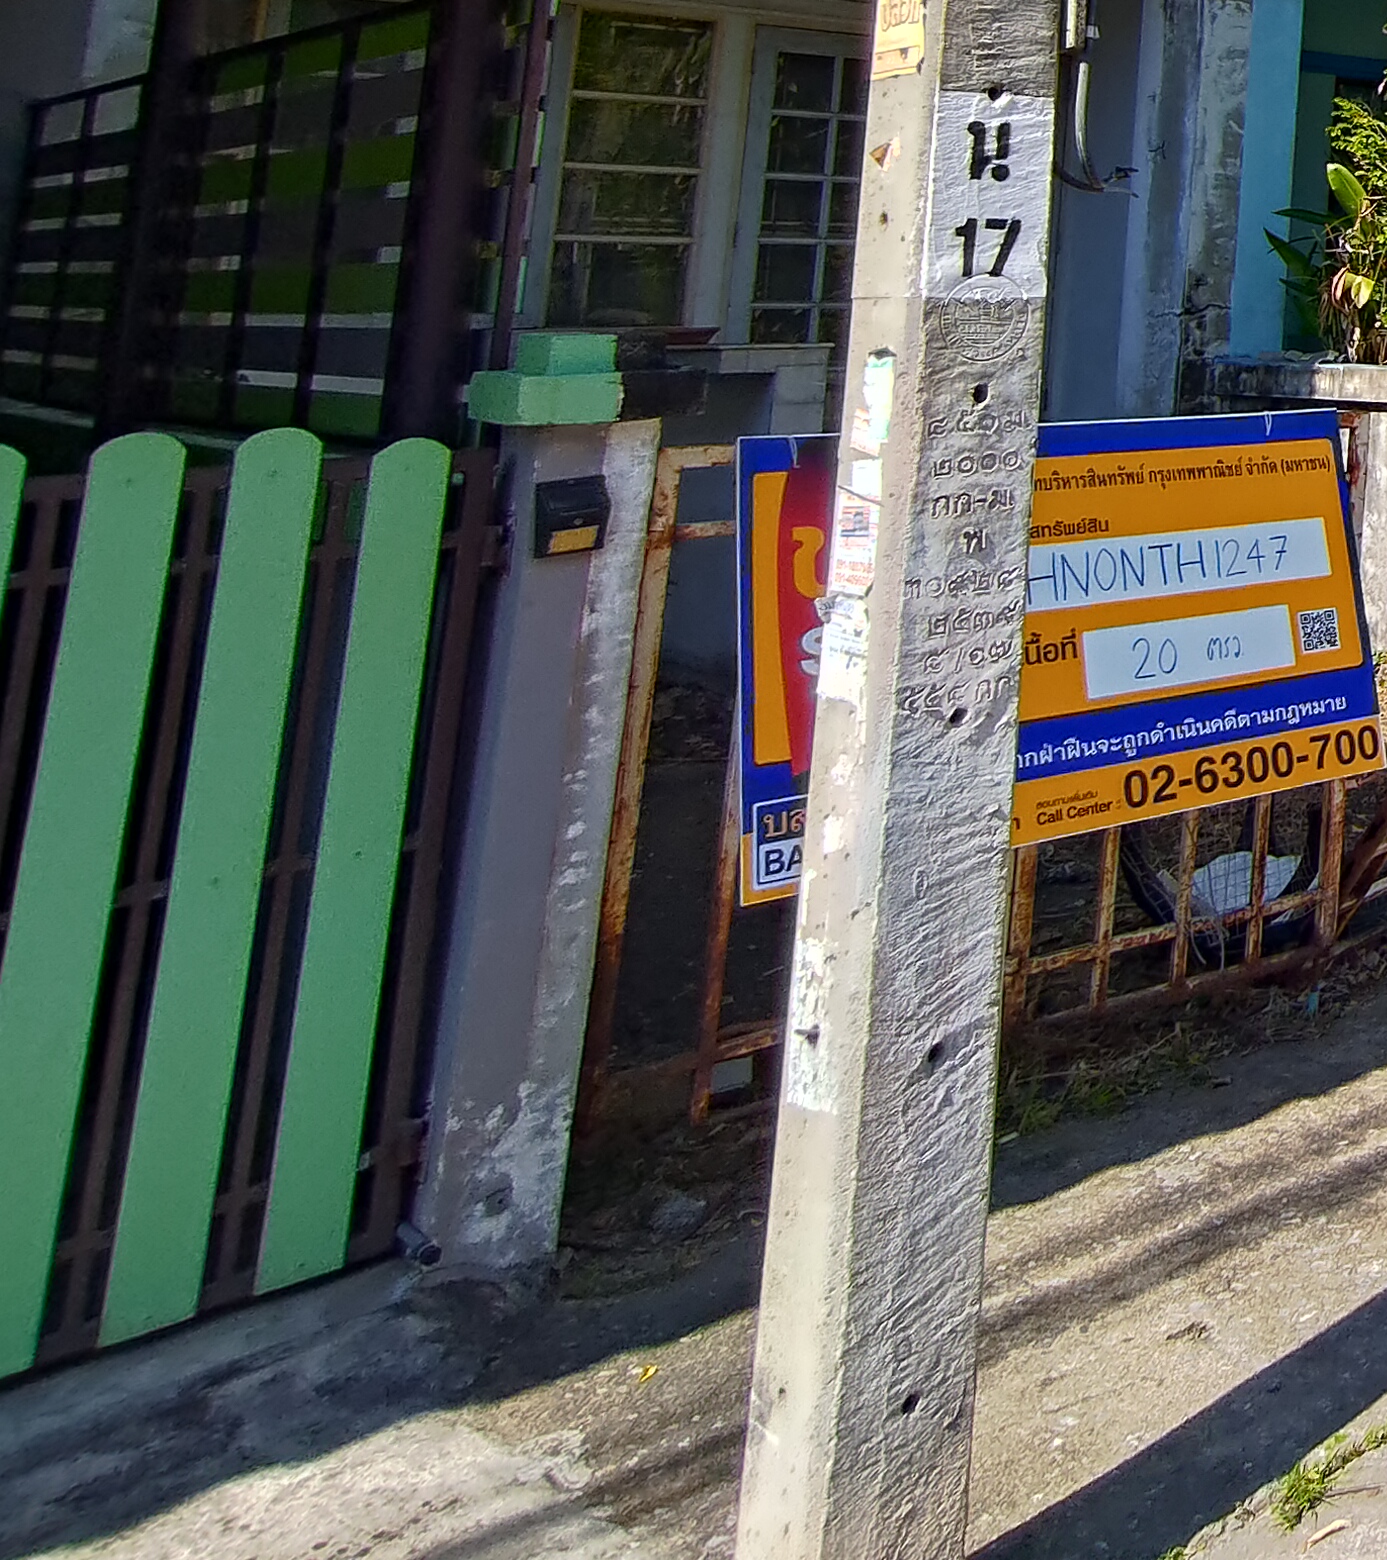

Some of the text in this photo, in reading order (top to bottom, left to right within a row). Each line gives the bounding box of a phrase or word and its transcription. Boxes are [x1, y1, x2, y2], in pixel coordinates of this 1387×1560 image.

[955, 218, 1022, 278] 17
[1246, 454, 1278, 476] จำกัด
[1281, 454, 1331, 476] (มหาชน)
[1131, 637, 1178, 680] 20
[1123, 724, 1380, 809] 02-6300-700
[1036, 808, 1063, 826] Call
[1066, 800, 1114, 819] Center
[764, 844, 804, 876] BA
